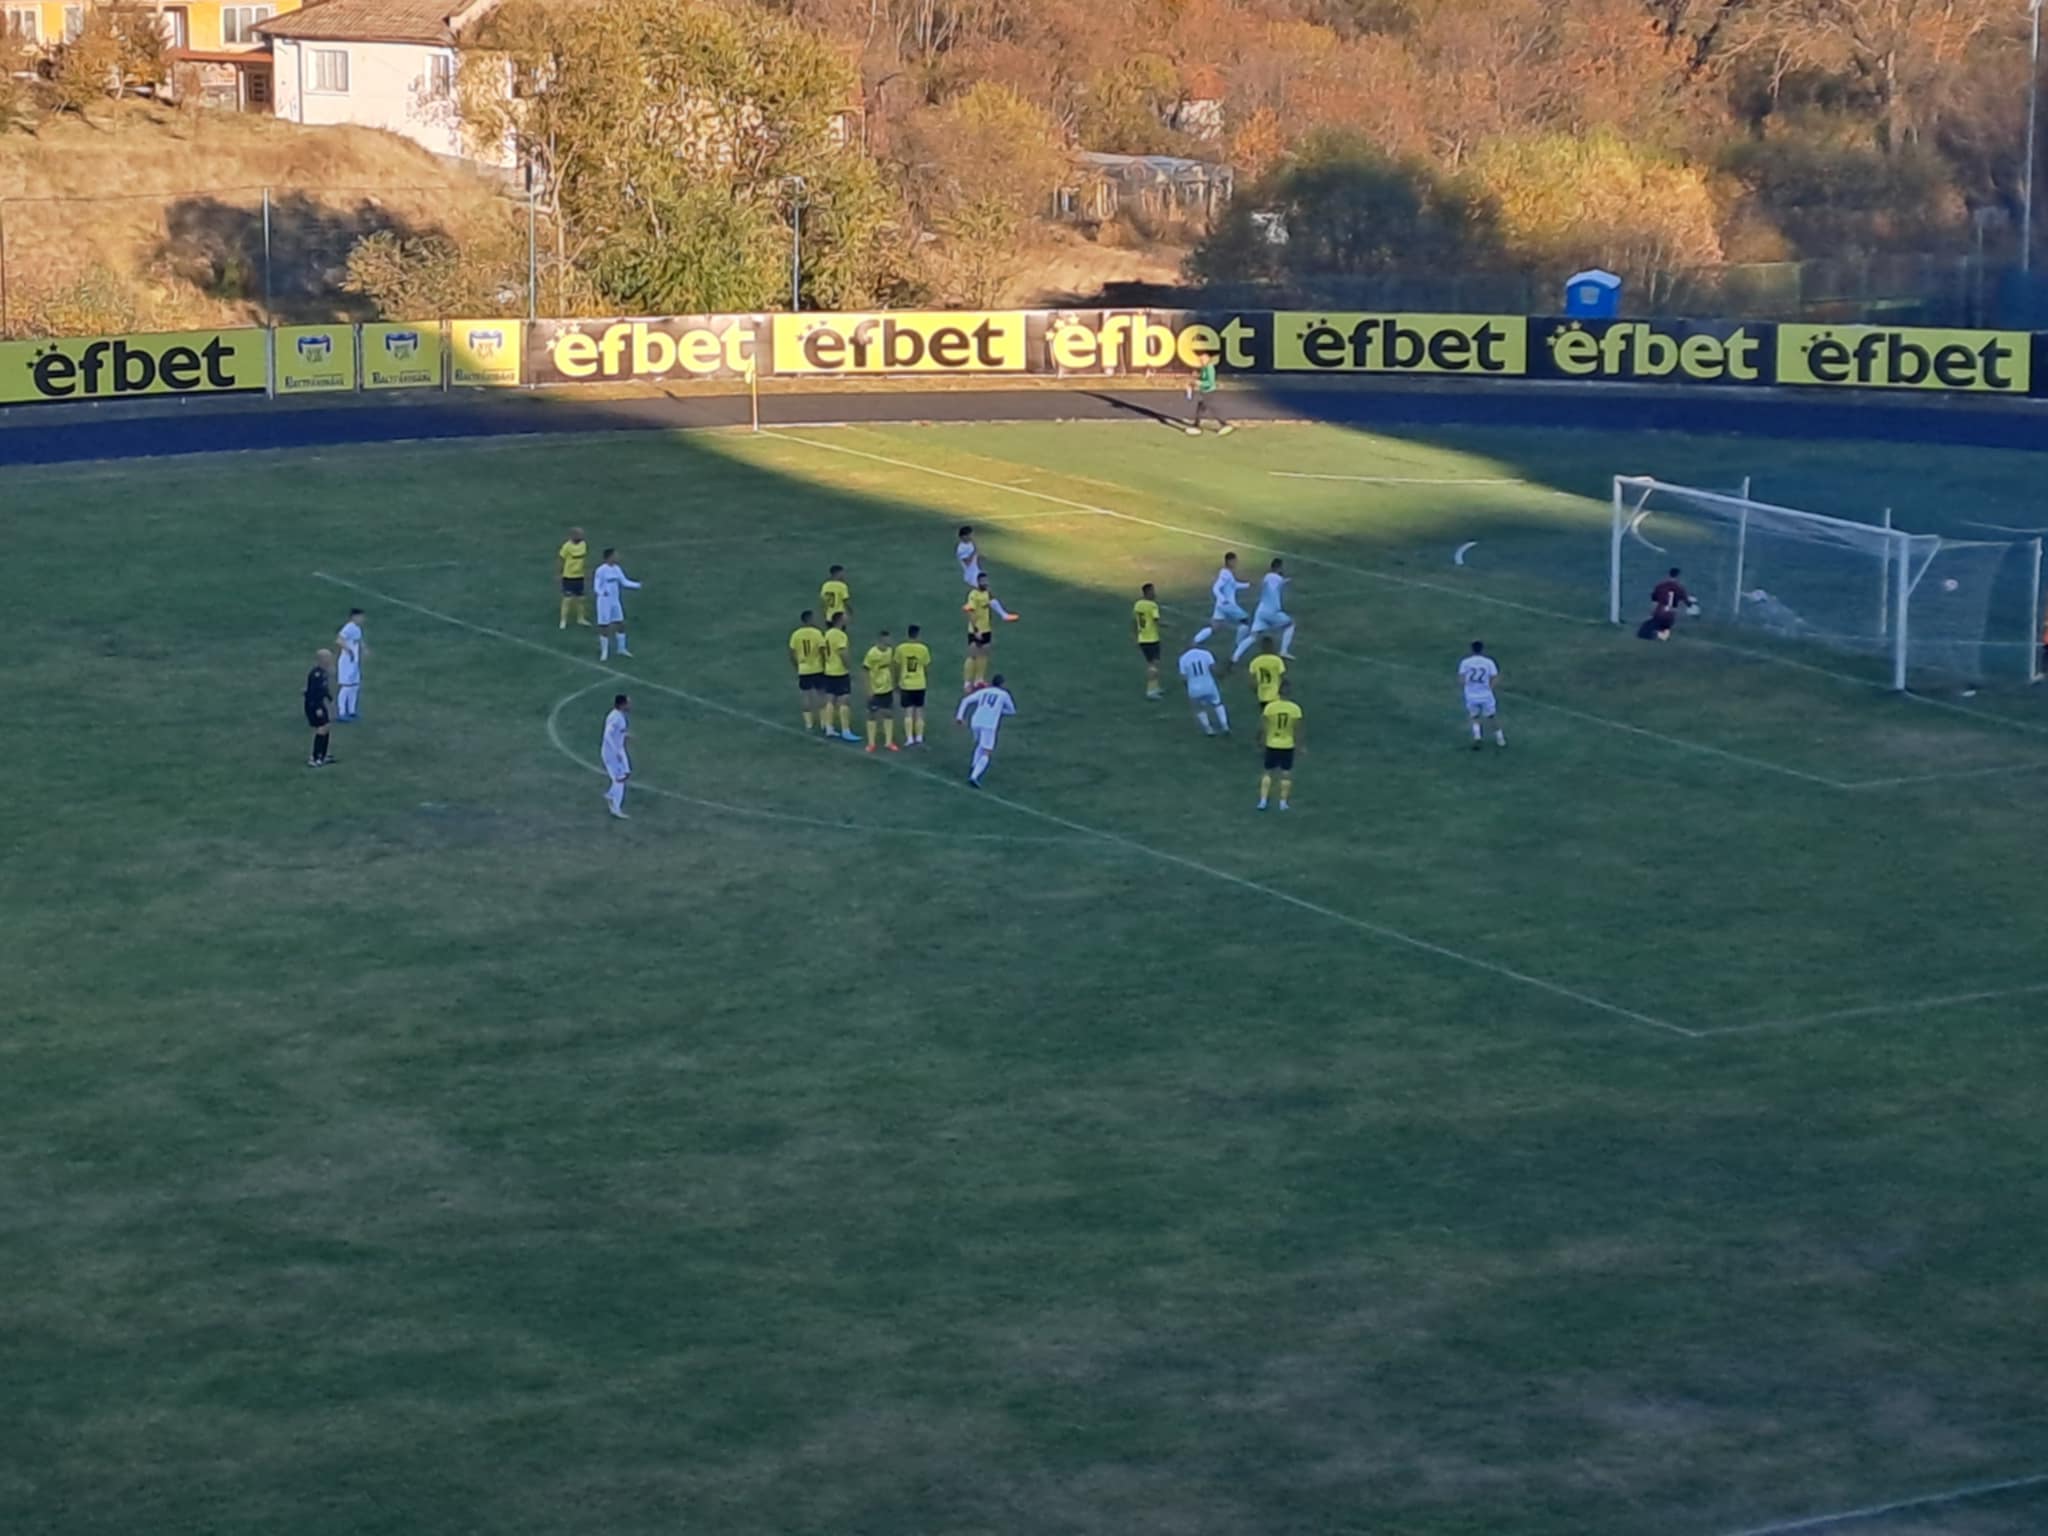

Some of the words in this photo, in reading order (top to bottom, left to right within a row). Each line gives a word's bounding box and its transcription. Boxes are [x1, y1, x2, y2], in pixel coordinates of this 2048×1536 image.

[32, 336, 235, 396] efbet
[553, 322, 755, 377] efbet
[802, 318, 1005, 369] efbet
[1051, 314, 1256, 369] efbet
[1302, 318, 1506, 371] efbet
[1552, 323, 1759, 379] efbet
[1807, 332, 2013, 388] efbet
[1191, 660, 1204, 677] 11
[1469, 666, 1486, 684] 22
[1277, 712, 1288, 729] 17
